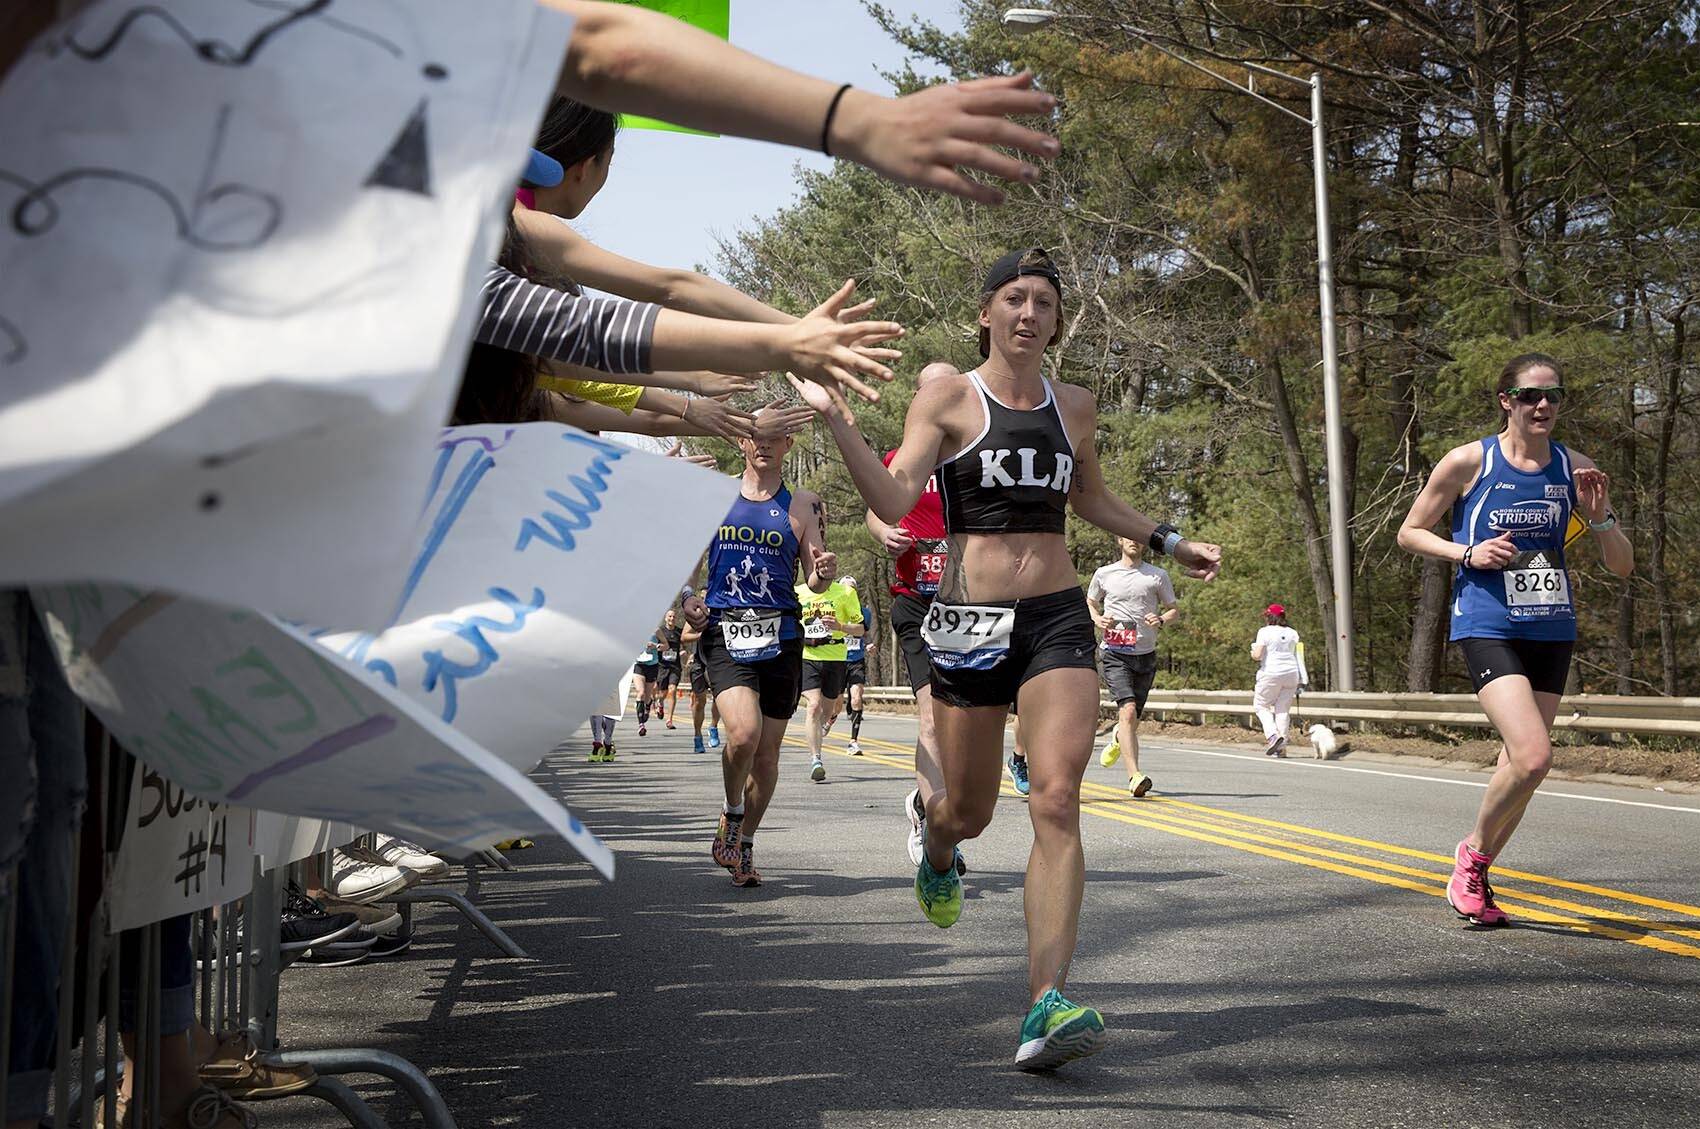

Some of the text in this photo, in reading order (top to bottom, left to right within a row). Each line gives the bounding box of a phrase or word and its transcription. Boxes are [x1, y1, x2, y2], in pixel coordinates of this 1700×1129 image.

[979, 447, 1073, 494] KLR
[1488, 510, 1549, 526] STRIDERS
[720, 542, 780, 556] running club
[1515, 572, 1561, 592] 8263
[729, 621, 776, 639] 9034
[928, 606, 1003, 637] 8927
[174, 815, 227, 898] #4
